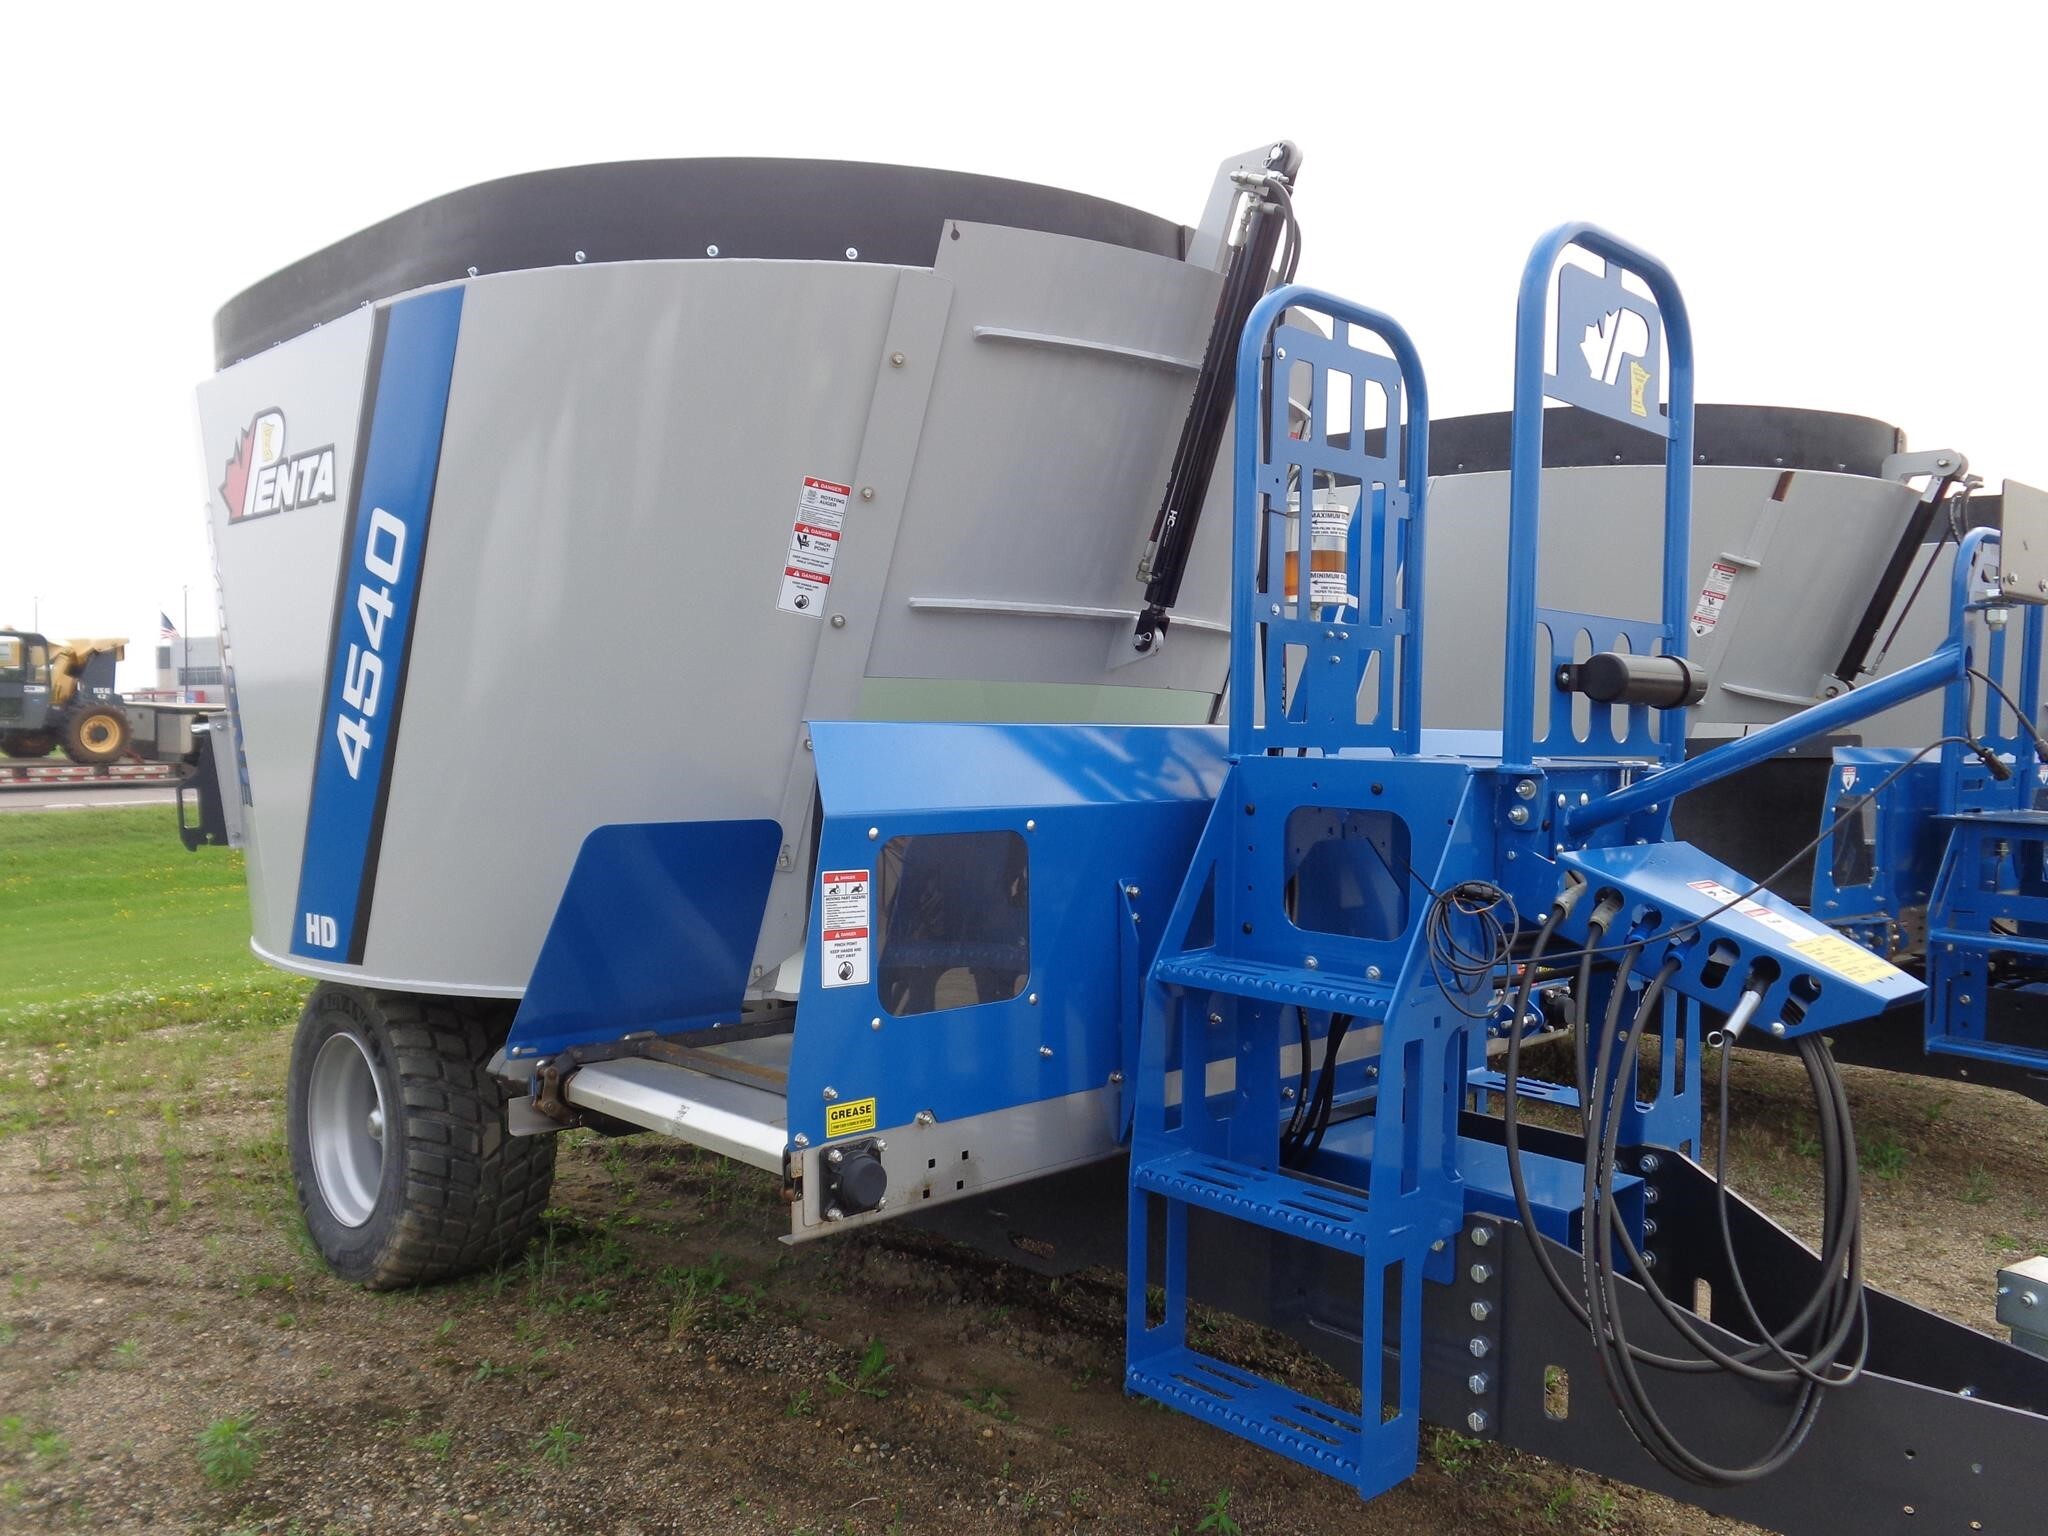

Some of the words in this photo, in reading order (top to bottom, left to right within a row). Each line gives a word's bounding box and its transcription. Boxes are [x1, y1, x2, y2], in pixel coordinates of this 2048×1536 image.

[242, 411, 335, 516] PENTA
[820, 483, 843, 493] DANGER
[819, 500, 837, 508] AUGER
[820, 494, 845, 504] ROTATING
[810, 528, 833, 537] DANGER
[814, 540, 832, 548] PINCH
[801, 572, 823, 581] DANGER
[336, 506, 407, 780] 4540
[306, 912, 338, 949] HD
[831, 1105, 871, 1120] GREASE
